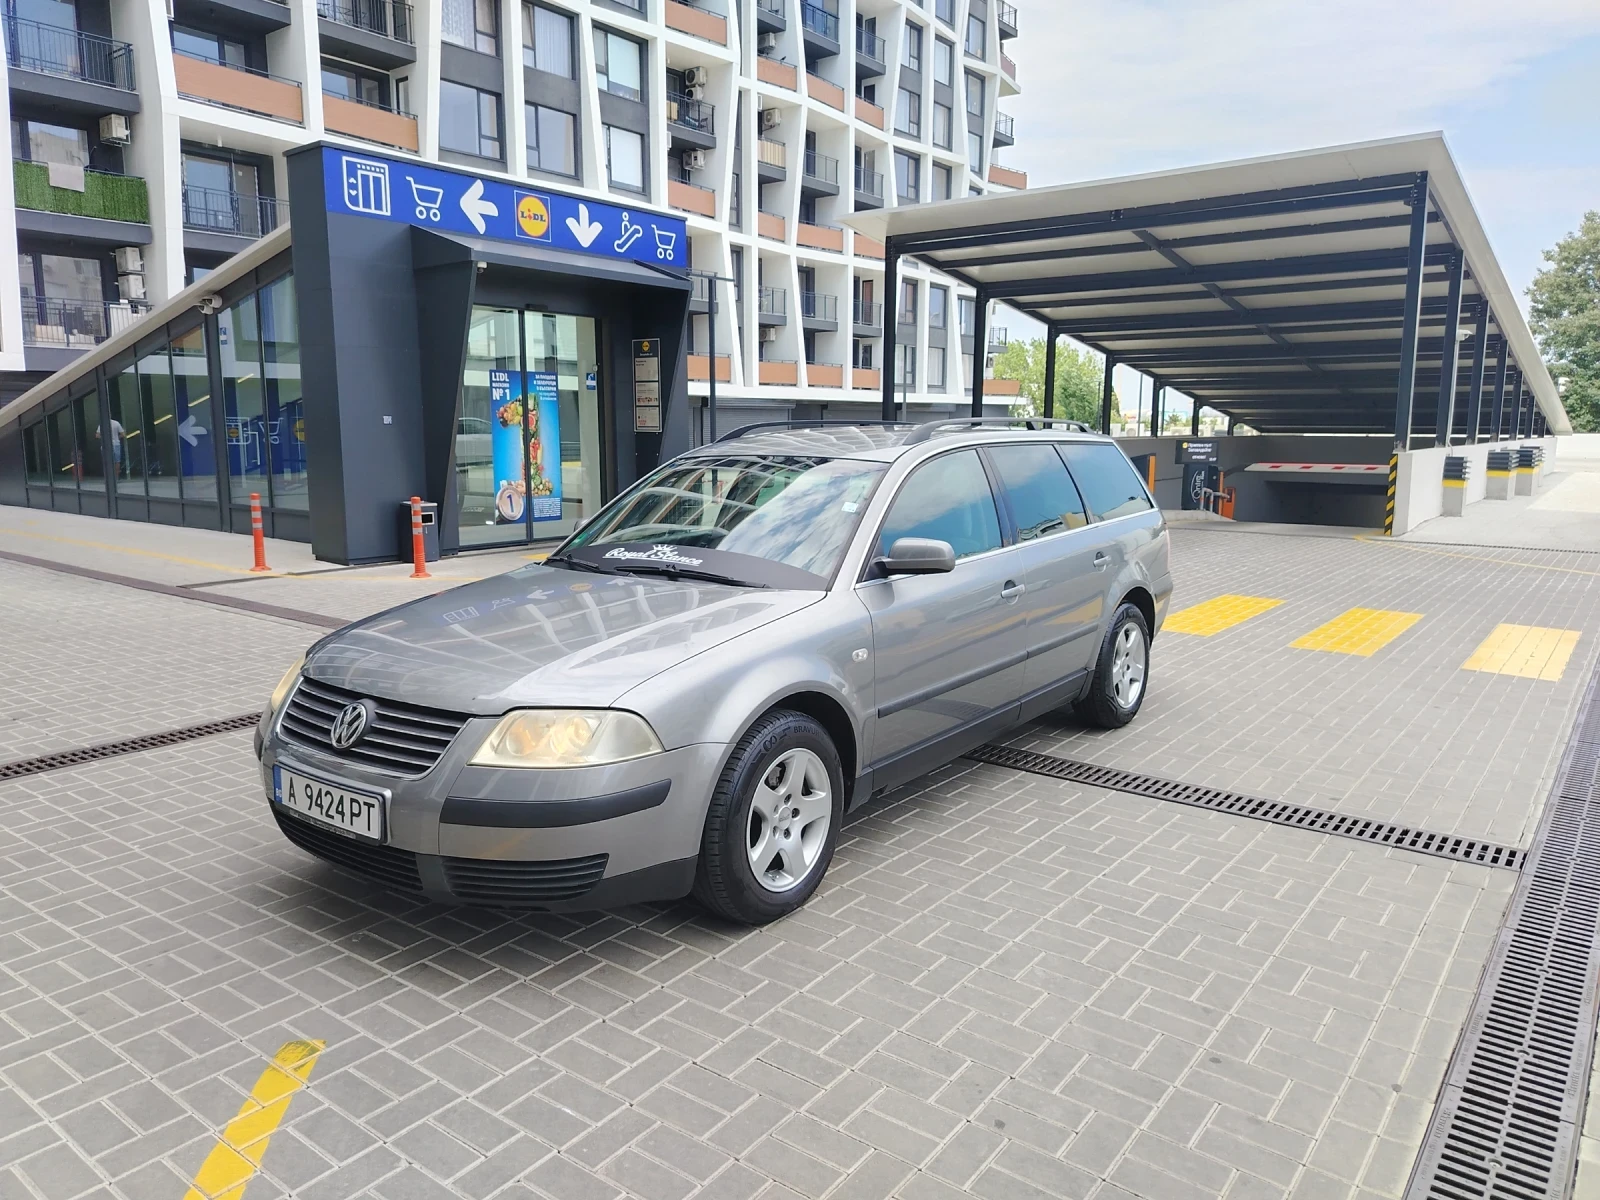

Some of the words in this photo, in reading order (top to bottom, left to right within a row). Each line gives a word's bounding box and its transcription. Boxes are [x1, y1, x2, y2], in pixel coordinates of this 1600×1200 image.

[492, 372, 509, 381] LIDL
[604, 547, 656, 560] Royal
[650, 551, 703, 565] Stance
[288, 776, 297, 805] A
